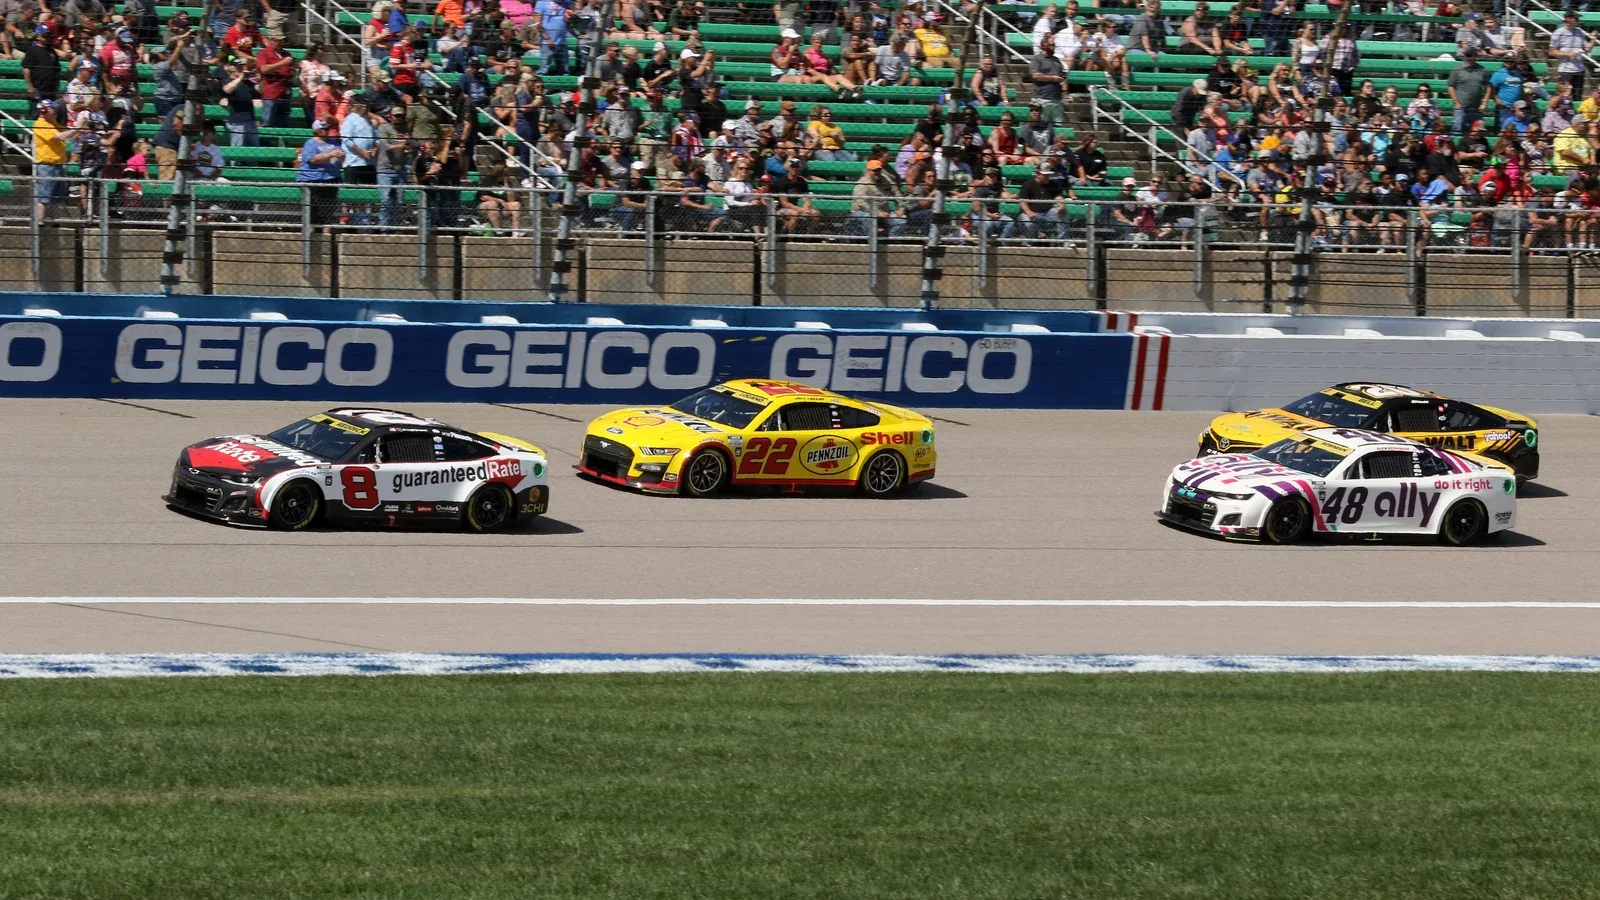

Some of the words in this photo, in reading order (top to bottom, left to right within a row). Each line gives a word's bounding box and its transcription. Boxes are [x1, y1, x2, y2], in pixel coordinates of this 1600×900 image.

[115, 324, 393, 387] GEICO
[445, 330, 716, 390] GEICO
[769, 334, 1033, 394] GEICO
[740, 392, 766, 403] LOGANO
[1358, 398, 1376, 406] BELL
[337, 422, 368, 435] REDDICK
[860, 431, 914, 446] Shell
[1484, 431, 1511, 442] yahoo!
[738, 437, 798, 474] 22
[807, 446, 850, 463] PENNZOIL
[340, 466, 381, 511] 8
[392, 462, 488, 493] guaranteed
[489, 461, 520, 478] Rate
[1434, 480, 1449, 490] do
[1453, 480, 1462, 490] it
[1464, 479, 1493, 492] right.
[521, 503, 544, 513] 3CHI
[1321, 487, 1369, 524] 48
[1374, 482, 1441, 528] ally
